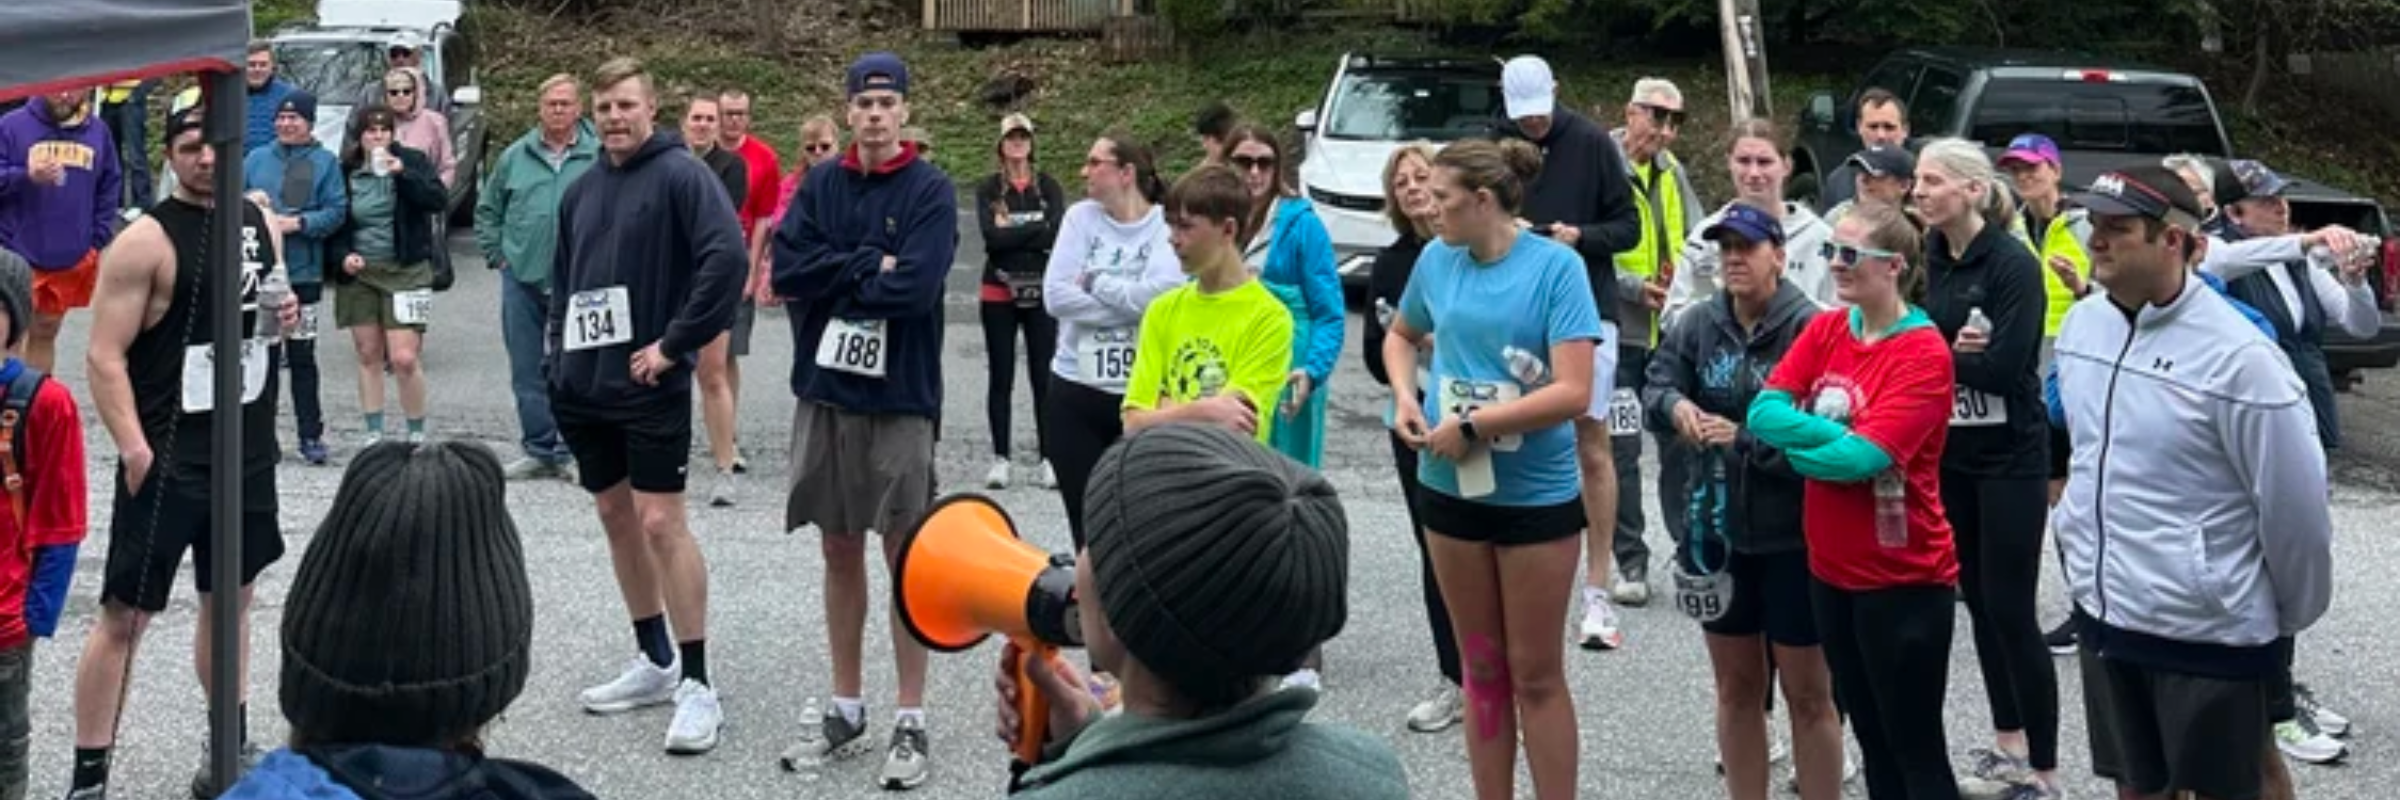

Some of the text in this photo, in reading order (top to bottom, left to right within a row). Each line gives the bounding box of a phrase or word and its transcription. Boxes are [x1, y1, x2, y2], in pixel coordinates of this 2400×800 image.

[576, 309, 615, 342] 134
[835, 333, 881, 369] 188
[1094, 348, 1135, 378] 159
[1951, 389, 1988, 419] 50
[1676, 593, 1720, 618] 199
